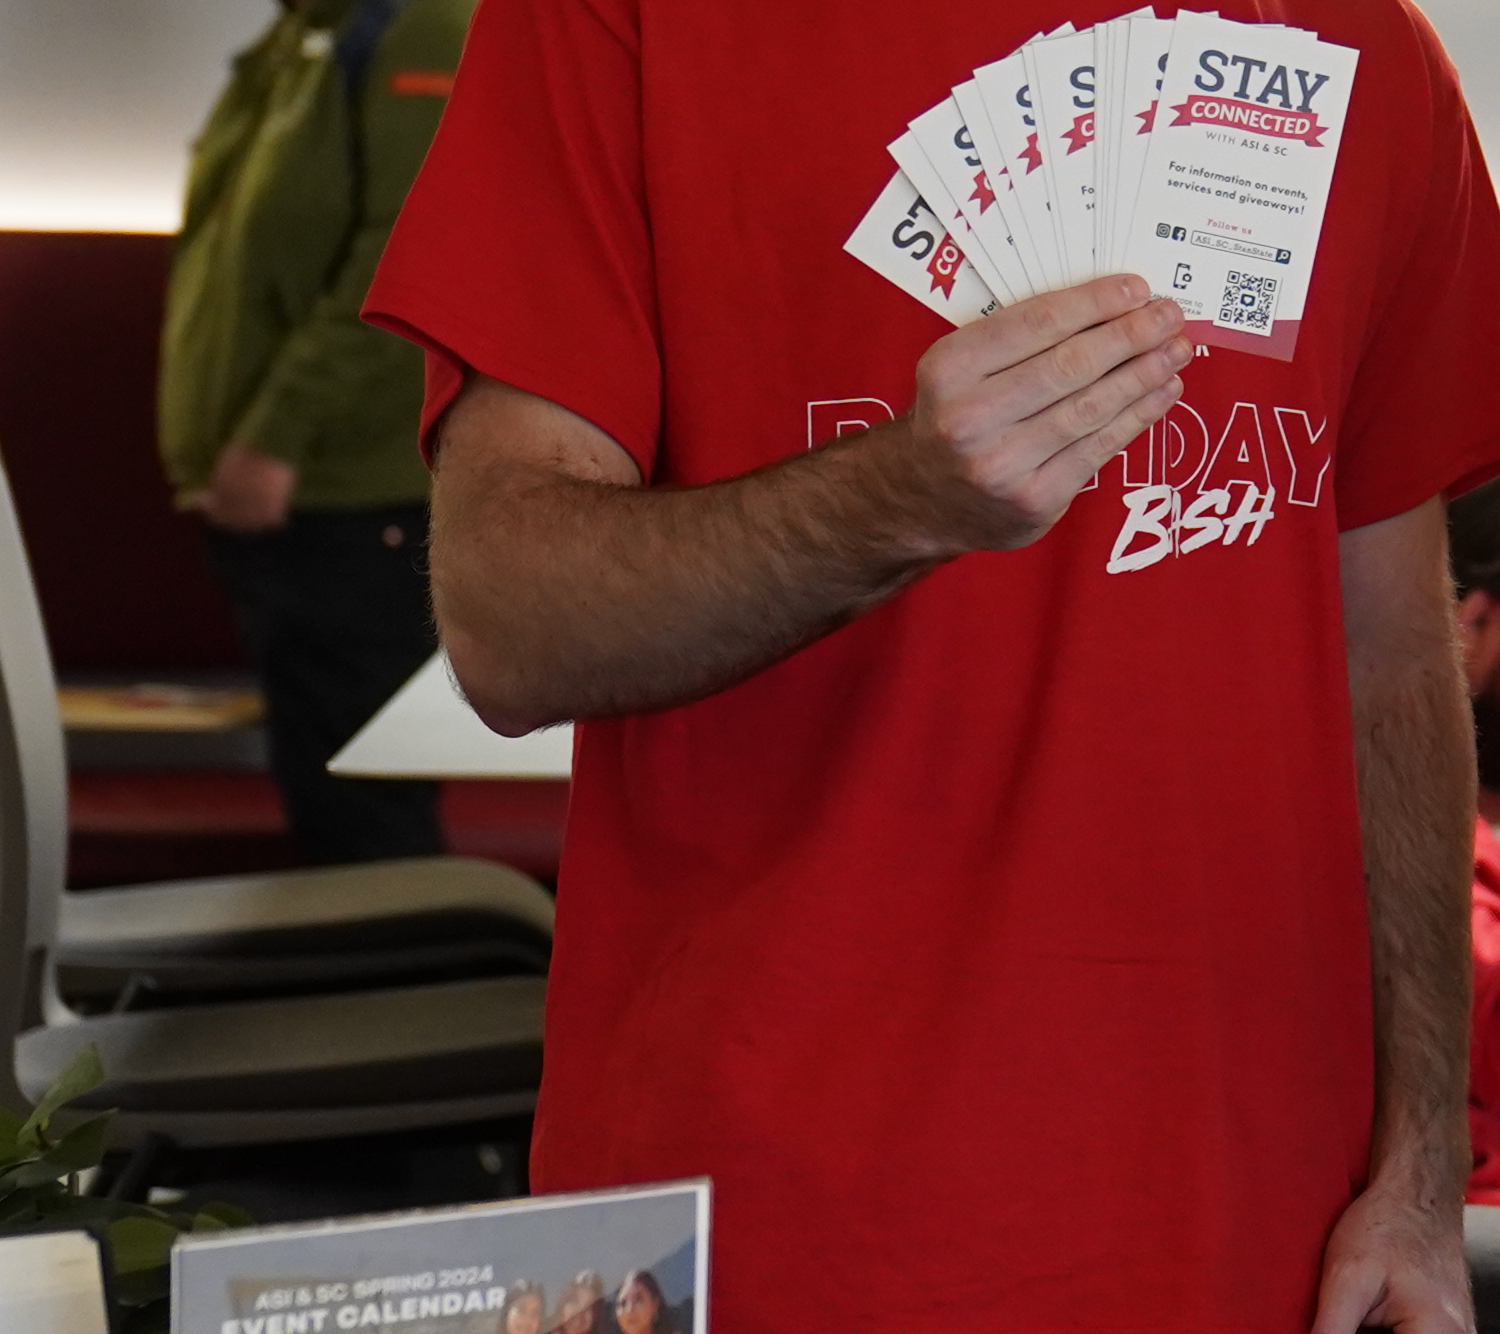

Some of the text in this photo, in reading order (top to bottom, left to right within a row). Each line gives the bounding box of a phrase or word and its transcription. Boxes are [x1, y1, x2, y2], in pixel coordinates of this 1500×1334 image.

[1194, 50, 1330, 113] STAY
[1191, 101, 1310, 135] CONNECTED
[1206, 131, 1287, 157] WITH ASI & SC
[1167, 178, 1305, 215] services and giveaways!
[1169, 161, 1308, 200] For information on events,
[1207, 218, 1252, 235] Follow us
[254, 1288, 294, 1310] ASI
[315, 1283, 349, 1303] SC
[436, 1264, 494, 1288] 2024
[336, 1286, 507, 1330] CALENDAR
